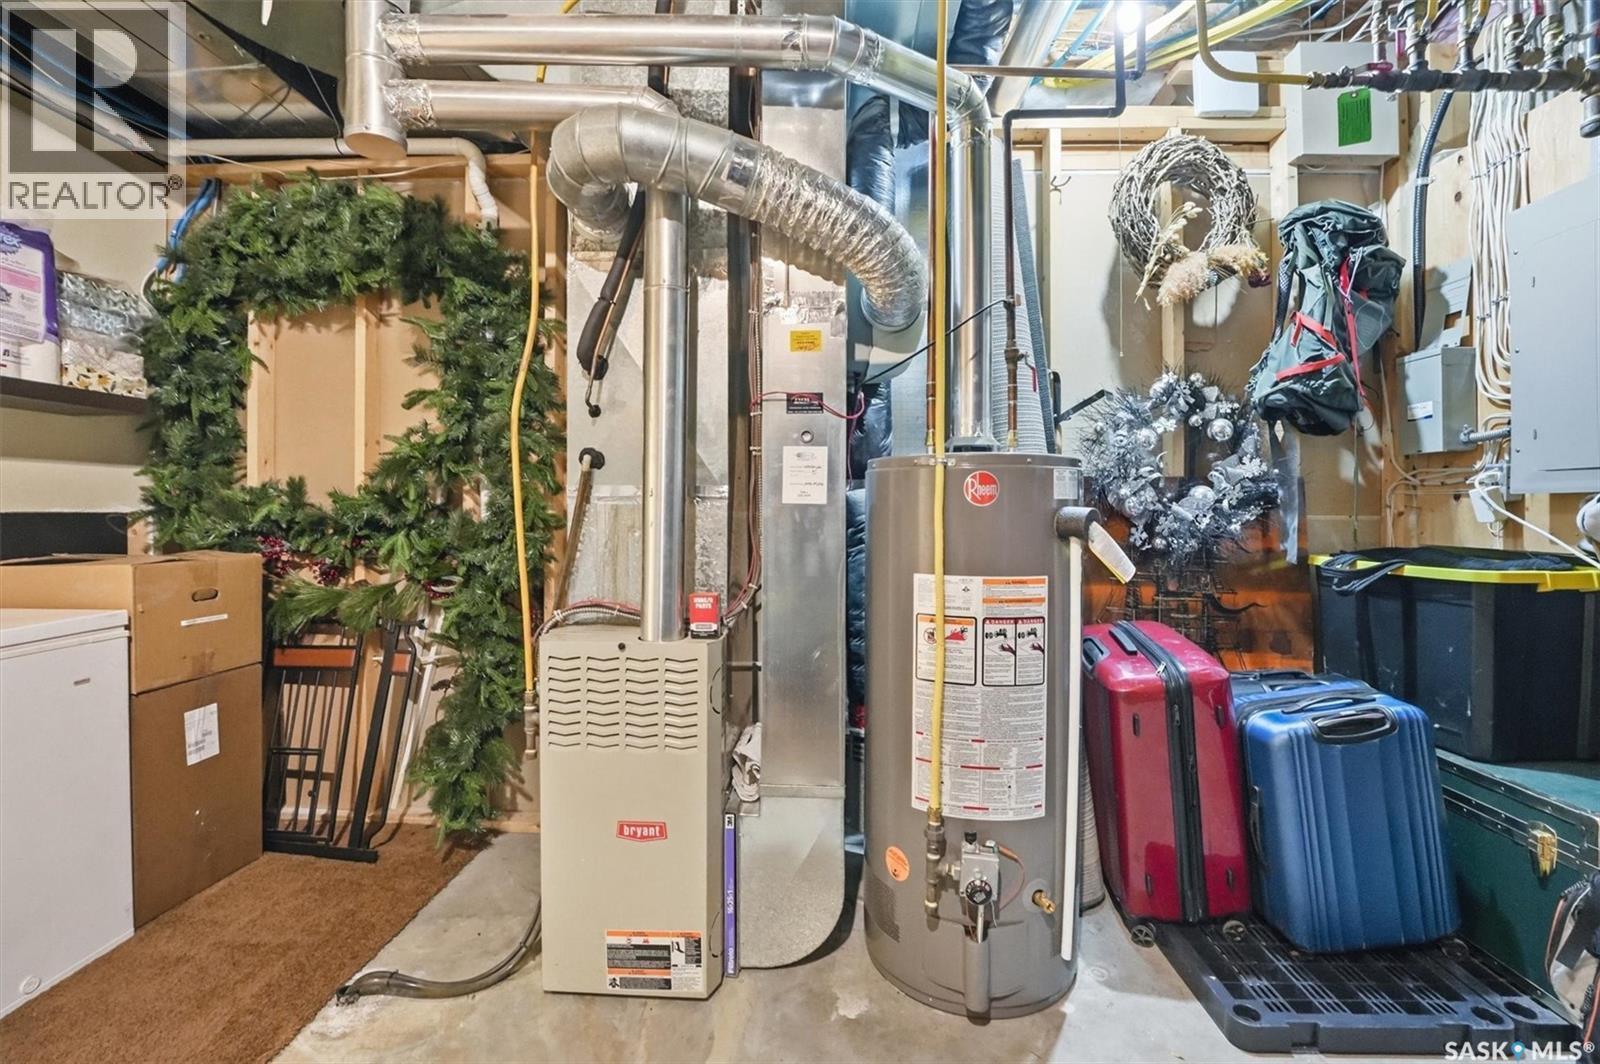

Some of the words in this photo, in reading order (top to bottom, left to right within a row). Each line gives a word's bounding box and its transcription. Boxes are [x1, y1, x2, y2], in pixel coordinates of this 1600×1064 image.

[967, 472, 998, 501] Rheem
[727, 815, 733, 828] 3M
[623, 824, 660, 838] bryant
